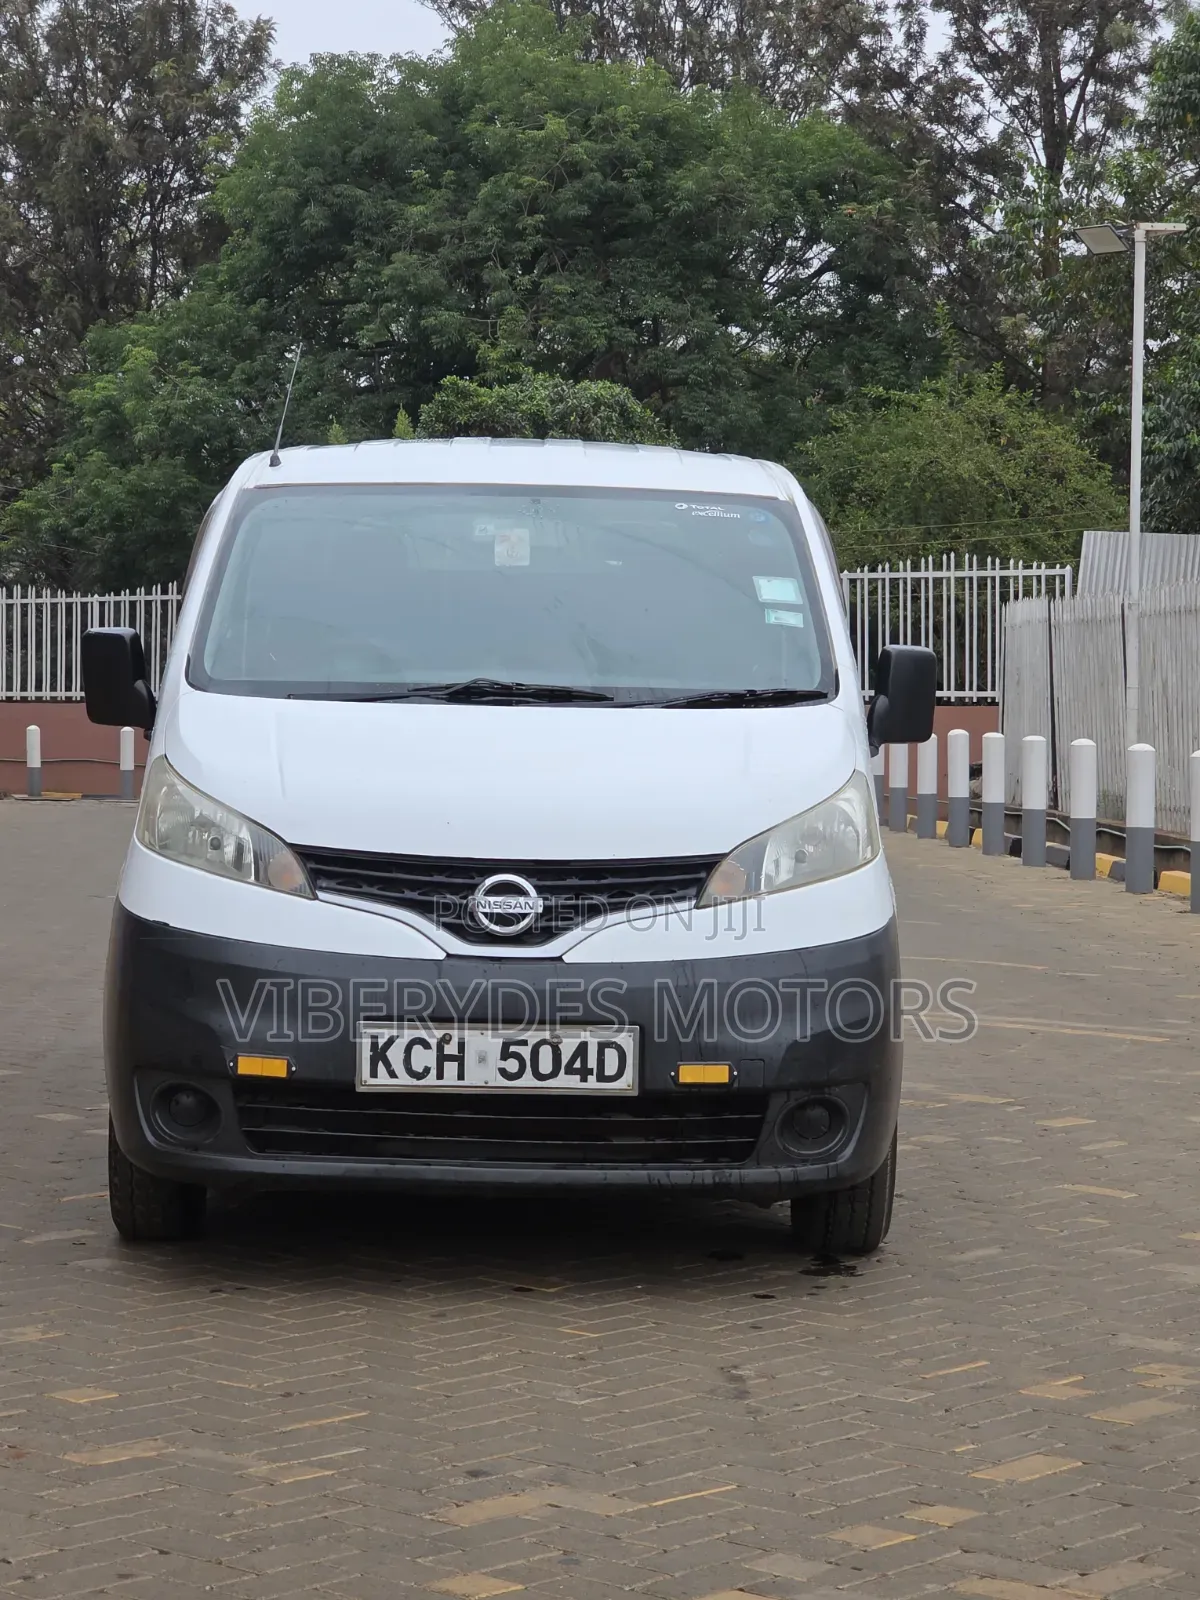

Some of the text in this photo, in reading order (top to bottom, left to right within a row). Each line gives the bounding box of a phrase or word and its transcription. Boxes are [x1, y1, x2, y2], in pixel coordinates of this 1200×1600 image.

[476, 900, 535, 911] NISSAN
[368, 1034, 628, 1084] KCH 504D
